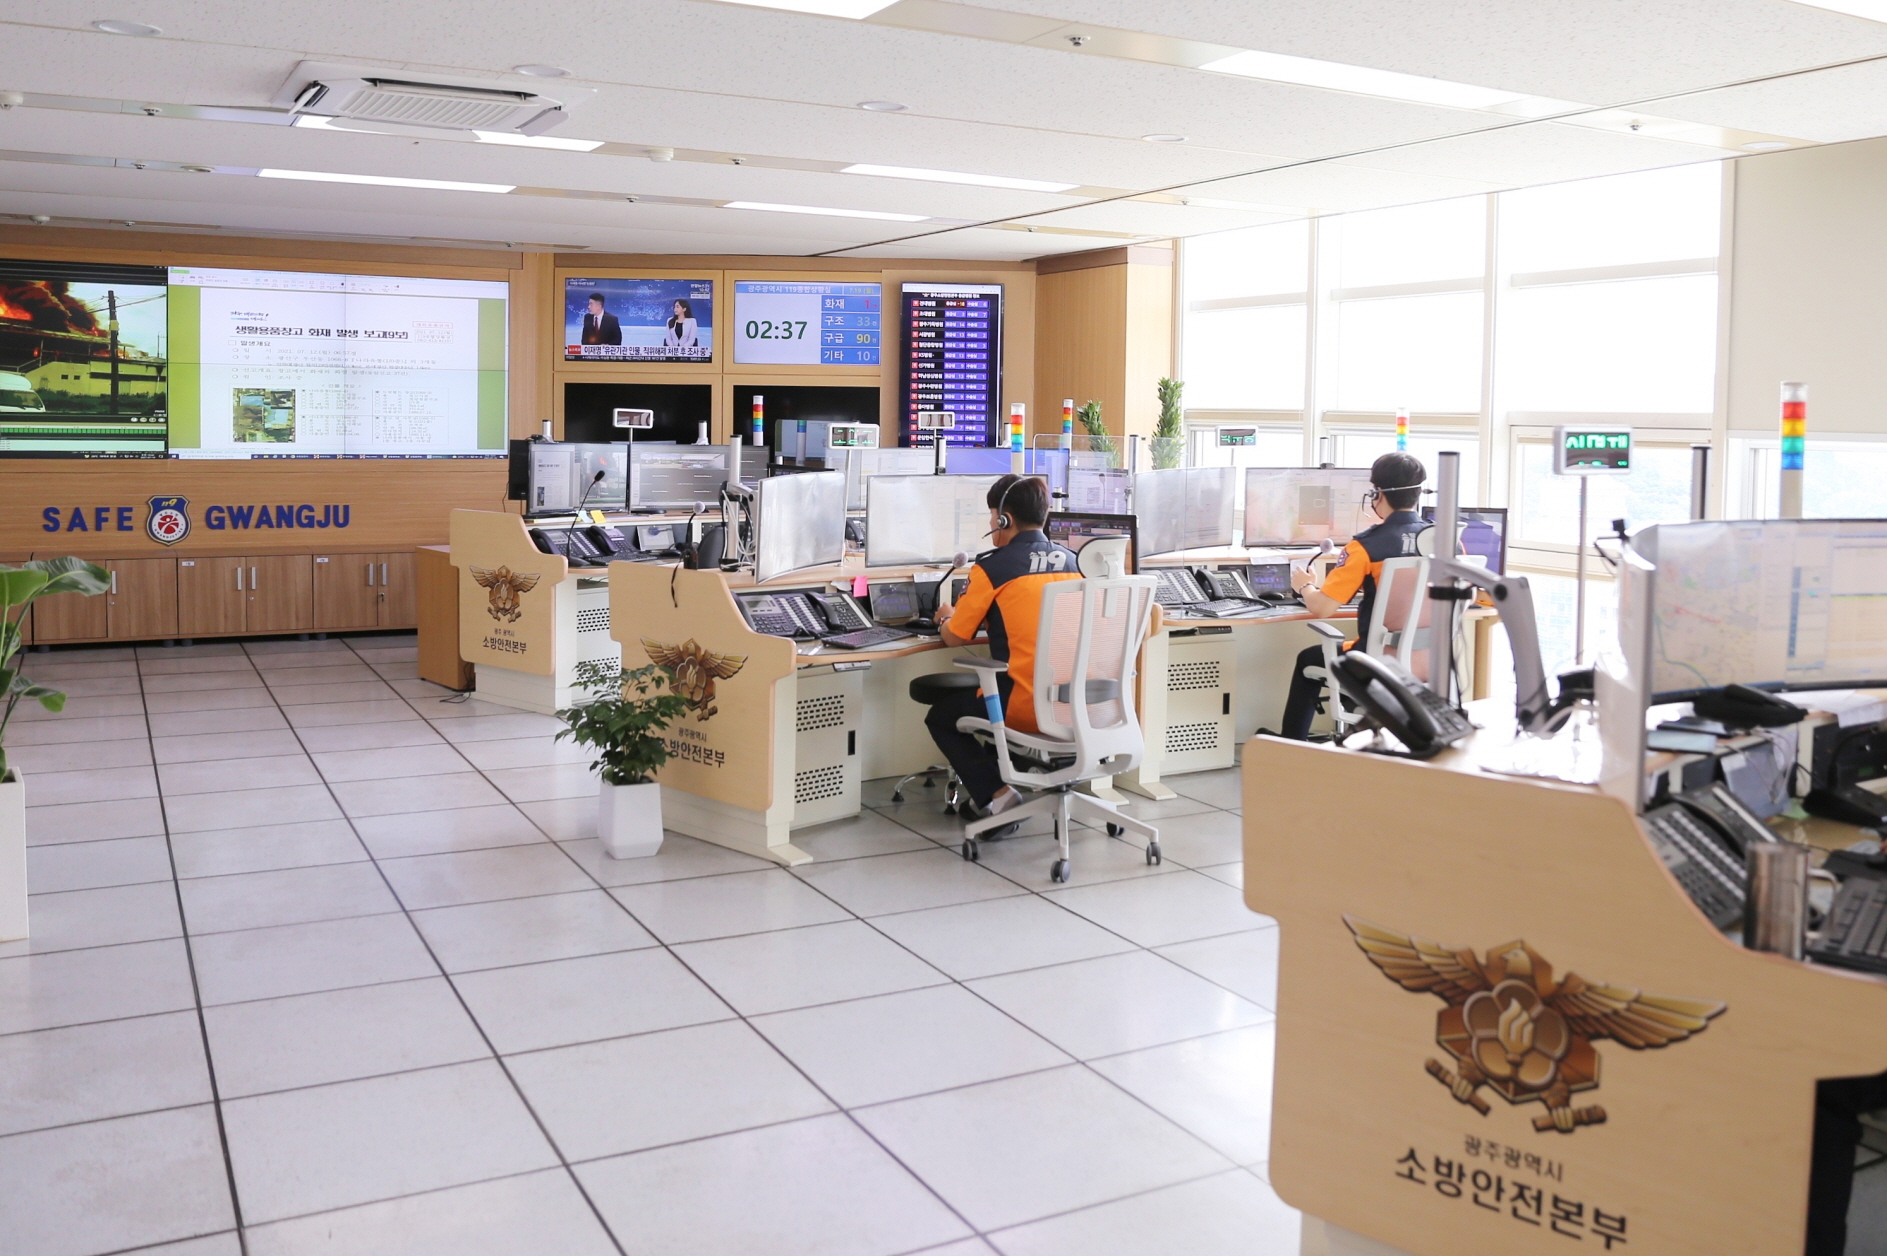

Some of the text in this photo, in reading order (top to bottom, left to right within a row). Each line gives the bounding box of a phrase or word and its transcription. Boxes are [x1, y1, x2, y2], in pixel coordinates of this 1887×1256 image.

[748, 285, 831, 294] 광주광역시 119종합상황실
[824, 298, 844, 309] 화재
[864, 300, 870, 308] 1
[824, 316, 844, 326] 구조
[856, 316, 870, 326] 33
[236, 326, 303, 336] 생활용품창고
[308, 328, 331, 338] 화재
[336, 329, 359, 338] 발생
[746, 320, 808, 340] 02:37
[824, 334, 844, 344] 구급
[856, 334, 870, 344] 90
[644, 347, 666, 355] 직위해제
[668, 347, 679, 356] 처분
[688, 348, 698, 356] 조사
[824, 350, 844, 362] 기타
[856, 351, 870, 361] 10
[43, 506, 134, 532] SAFE
[205, 504, 350, 530] GWANGJU
[1029, 551, 1066, 573] 119
[483, 636, 526, 654] 소방안전본부
[679, 727, 706, 742] 광주광역시
[1464, 1134, 1562, 1182] 광주광역시
[1396, 1148, 1627, 1250] 소방안전본부
